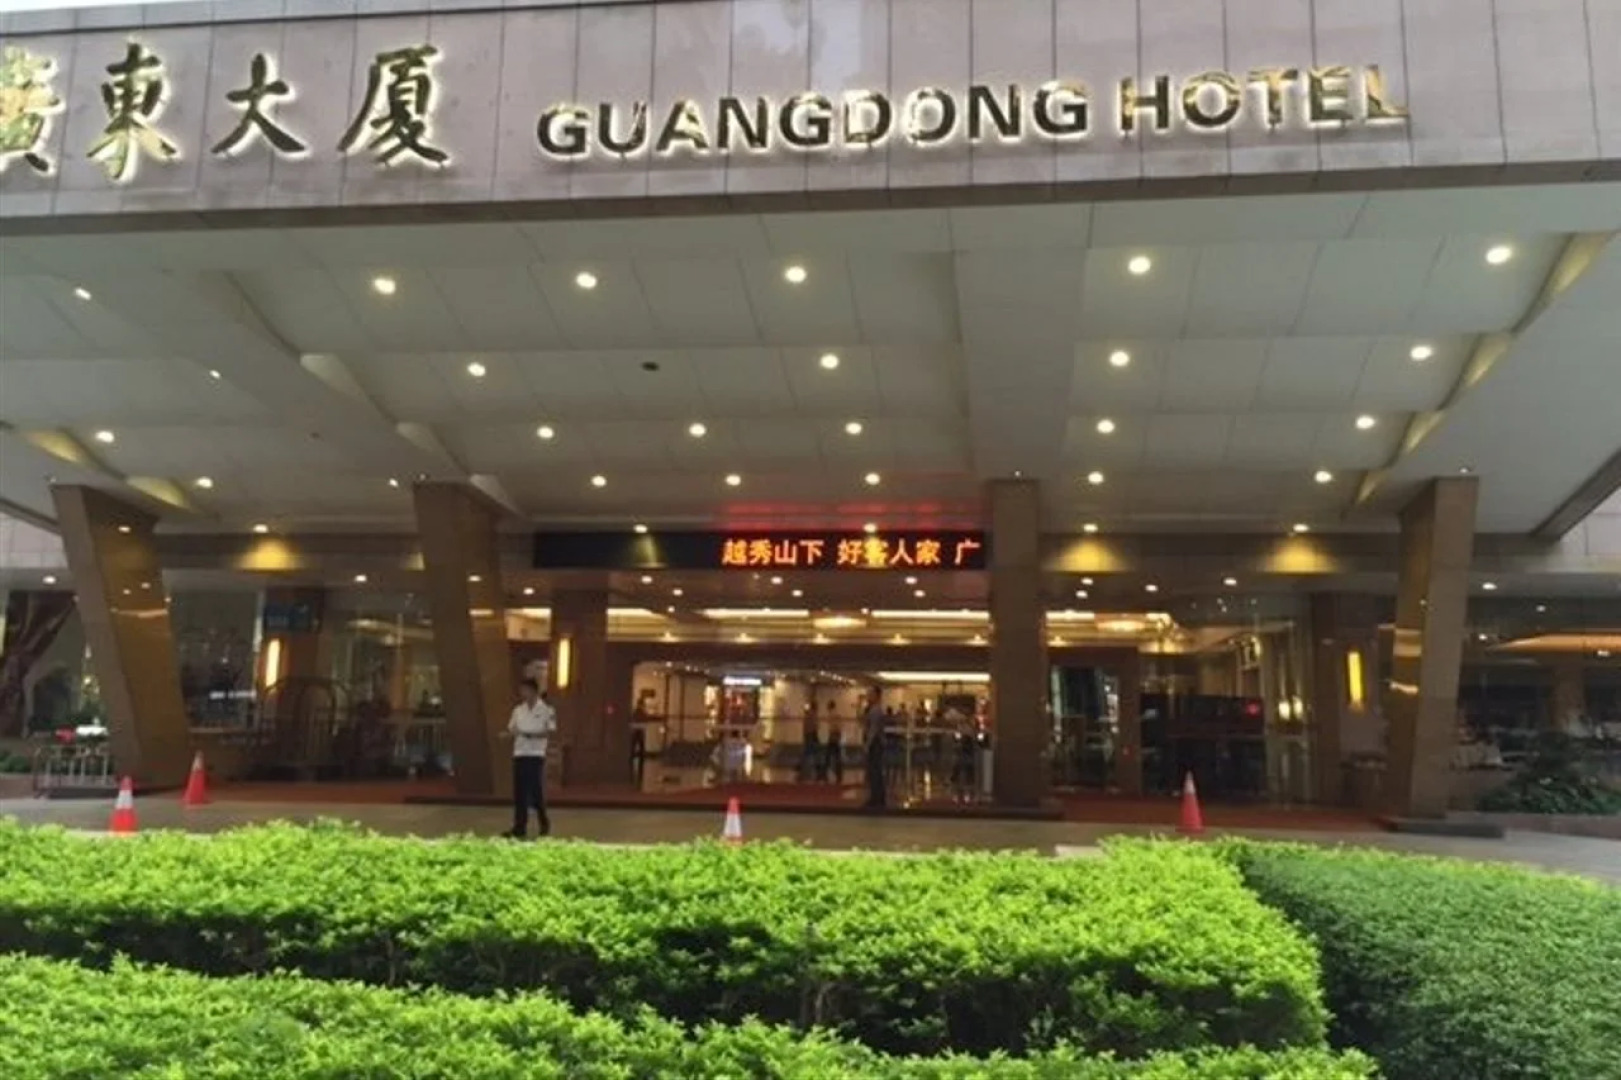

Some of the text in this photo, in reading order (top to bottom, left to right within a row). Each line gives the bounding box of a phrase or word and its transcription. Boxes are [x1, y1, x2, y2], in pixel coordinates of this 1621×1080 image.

[537, 64, 1409, 159] GUANGDONG HOTEL
[722, 538, 824, 566] 越秀山下
[954, 538, 981, 565] 广
